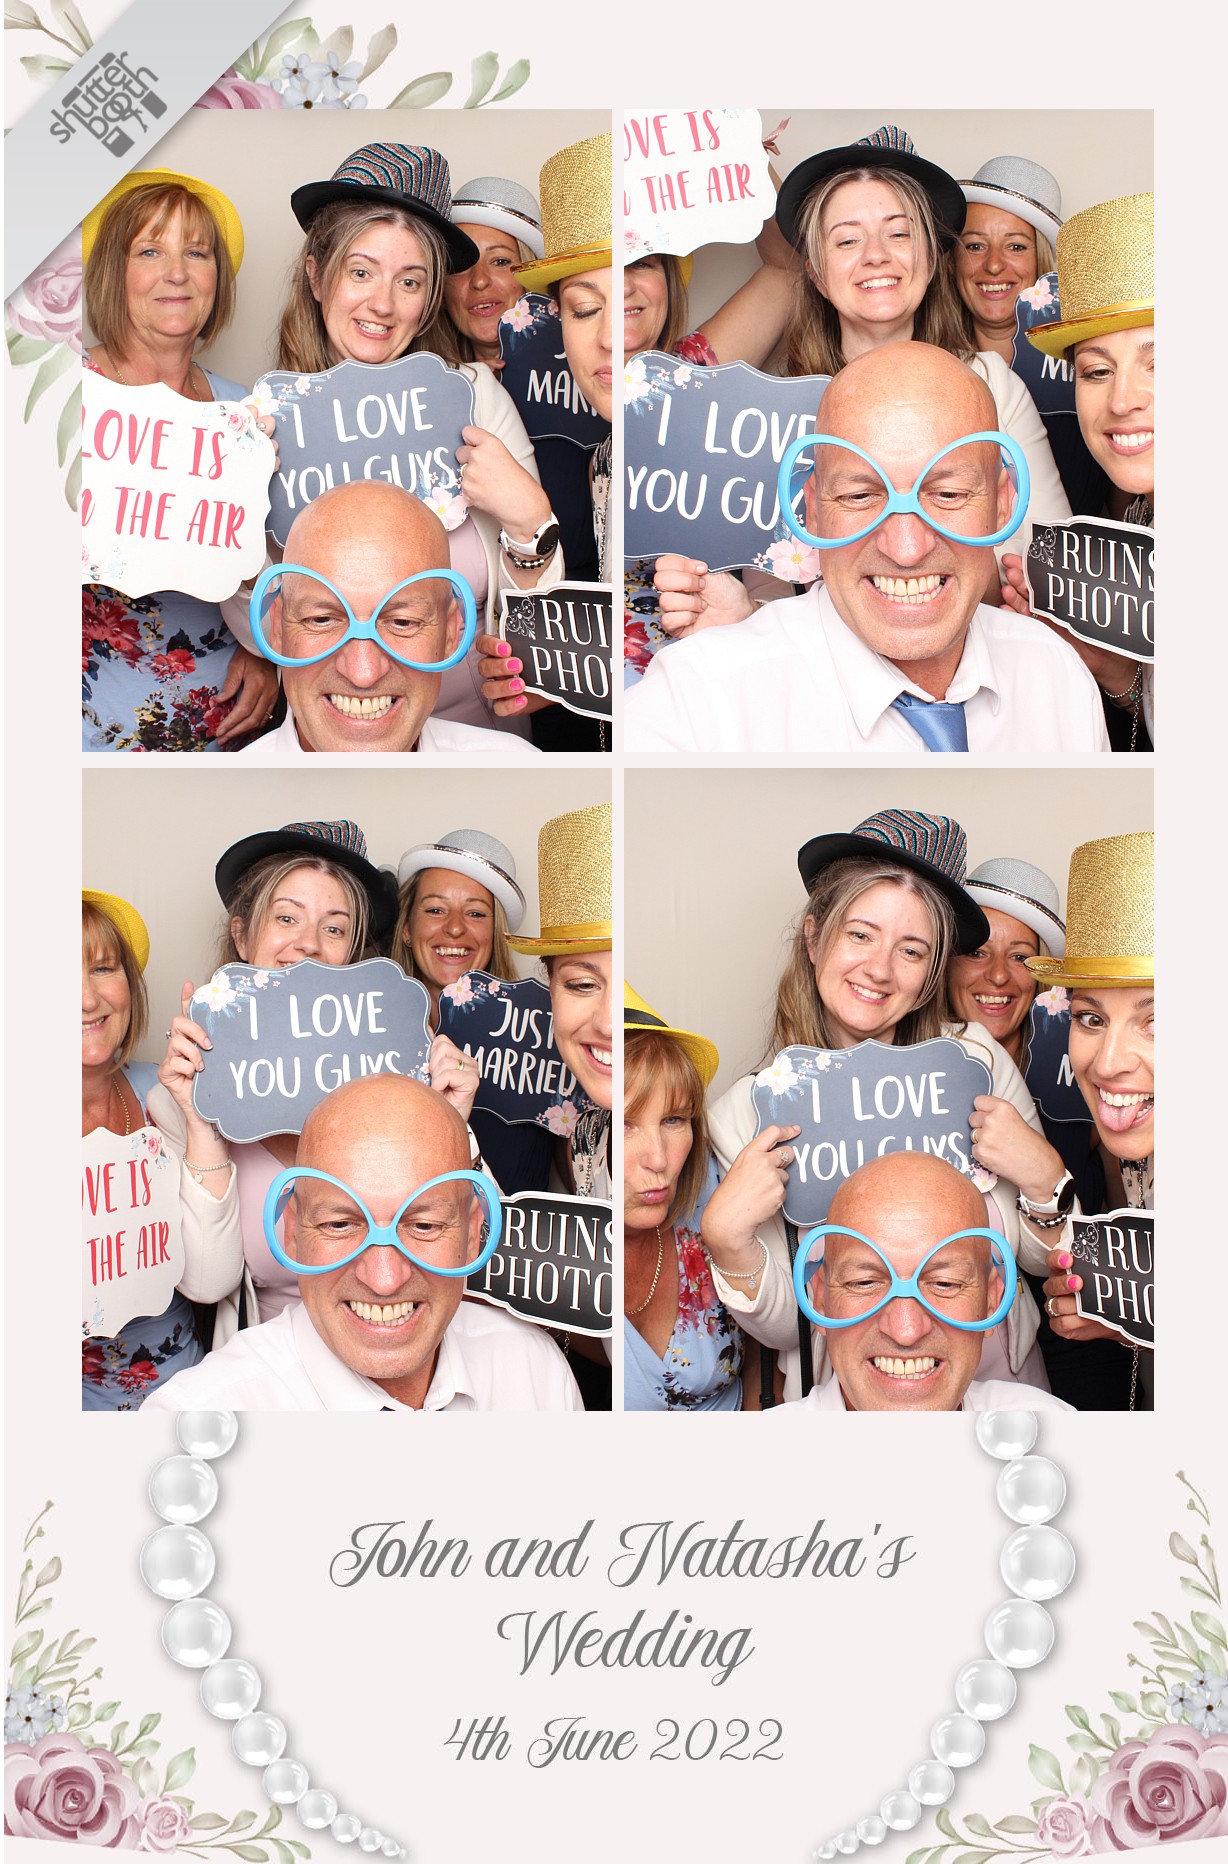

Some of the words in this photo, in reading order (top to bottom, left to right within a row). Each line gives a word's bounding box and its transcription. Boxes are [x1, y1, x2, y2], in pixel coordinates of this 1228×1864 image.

[683, 109, 720, 152] IS
[640, 170, 695, 214] THE
[707, 163, 755, 203] AIR
[293, 403, 305, 448] I
[333, 387, 433, 443] LOVE
[658, 394, 671, 446] I
[705, 401, 816, 464] LOVE
[189, 426, 228, 480] IS
[115, 486, 176, 540] THE
[187, 499, 245, 550] AIR
[628, 466, 707, 520] YOU
[540, 599, 612, 648] RUI
[530, 646, 612, 698] PHO
[249, 995, 259, 1040] I
[289, 991, 387, 1038] LOVE
[229, 1056, 301, 1099] YOU
[463, 1043, 577, 1096] MARRIED
[812, 1078, 821, 1123] I
[852, 1072, 949, 1121] LOVE
[82, 1163, 117, 1216] VE
[127, 1158, 152, 1208] IS
[793, 1140, 863, 1183] YOU
[86, 1230, 127, 1287] THE
[137, 1221, 171, 1270] AIR
